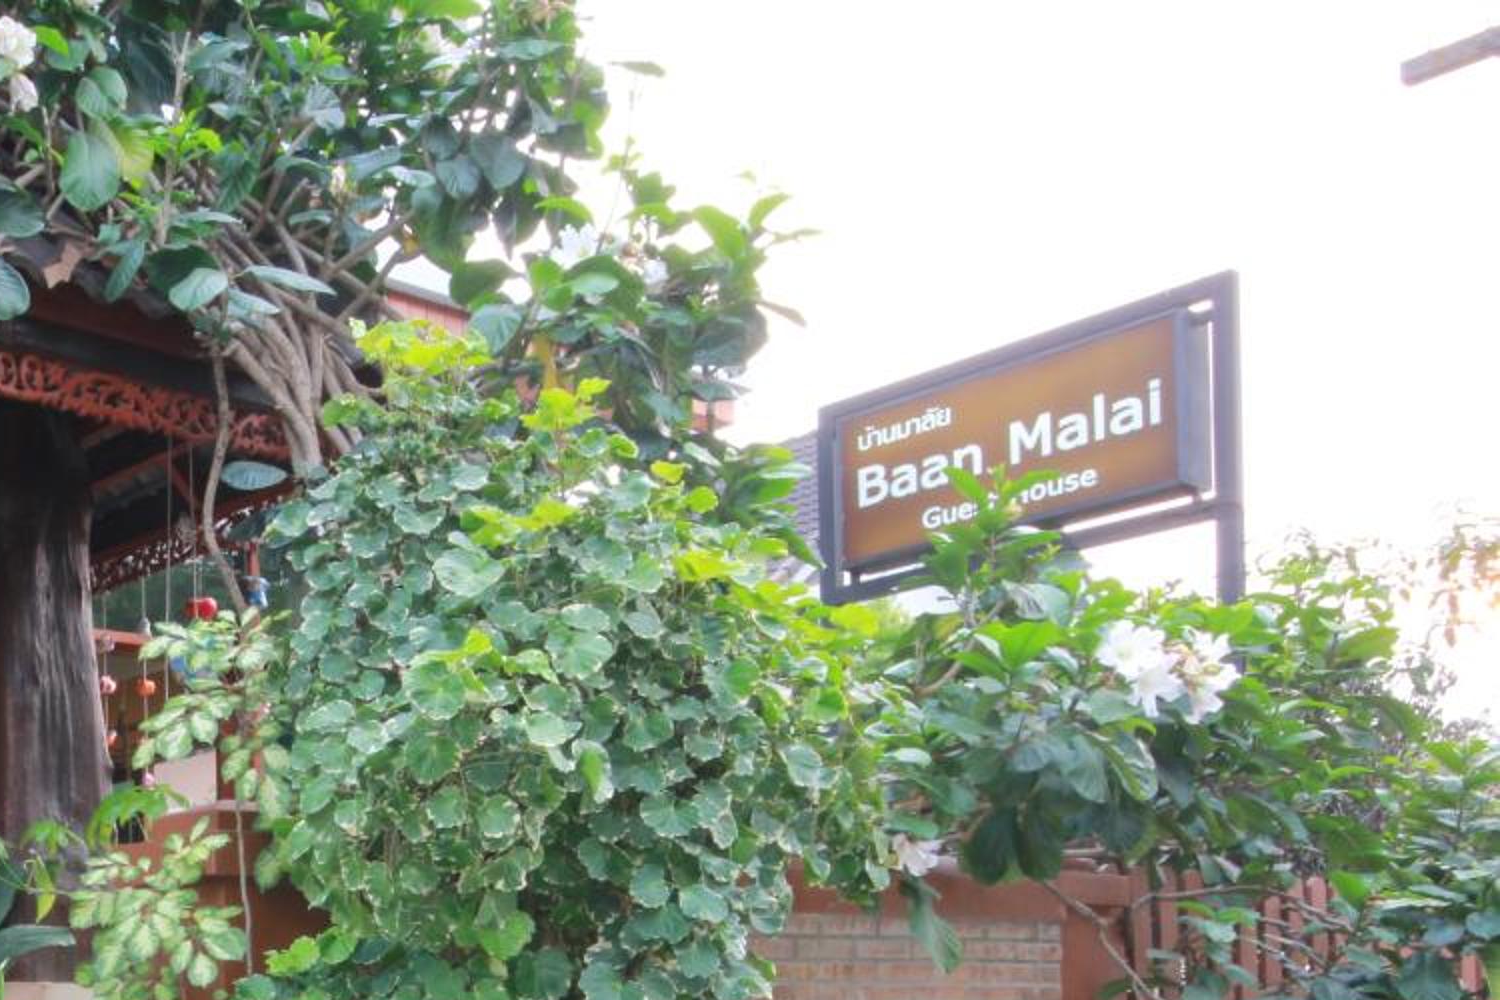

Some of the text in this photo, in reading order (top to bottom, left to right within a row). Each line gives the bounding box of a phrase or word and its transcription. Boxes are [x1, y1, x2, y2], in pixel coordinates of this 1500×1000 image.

[857, 405, 952, 452] บ้านมาลัย
[857, 378, 1162, 509] Baan Malai
